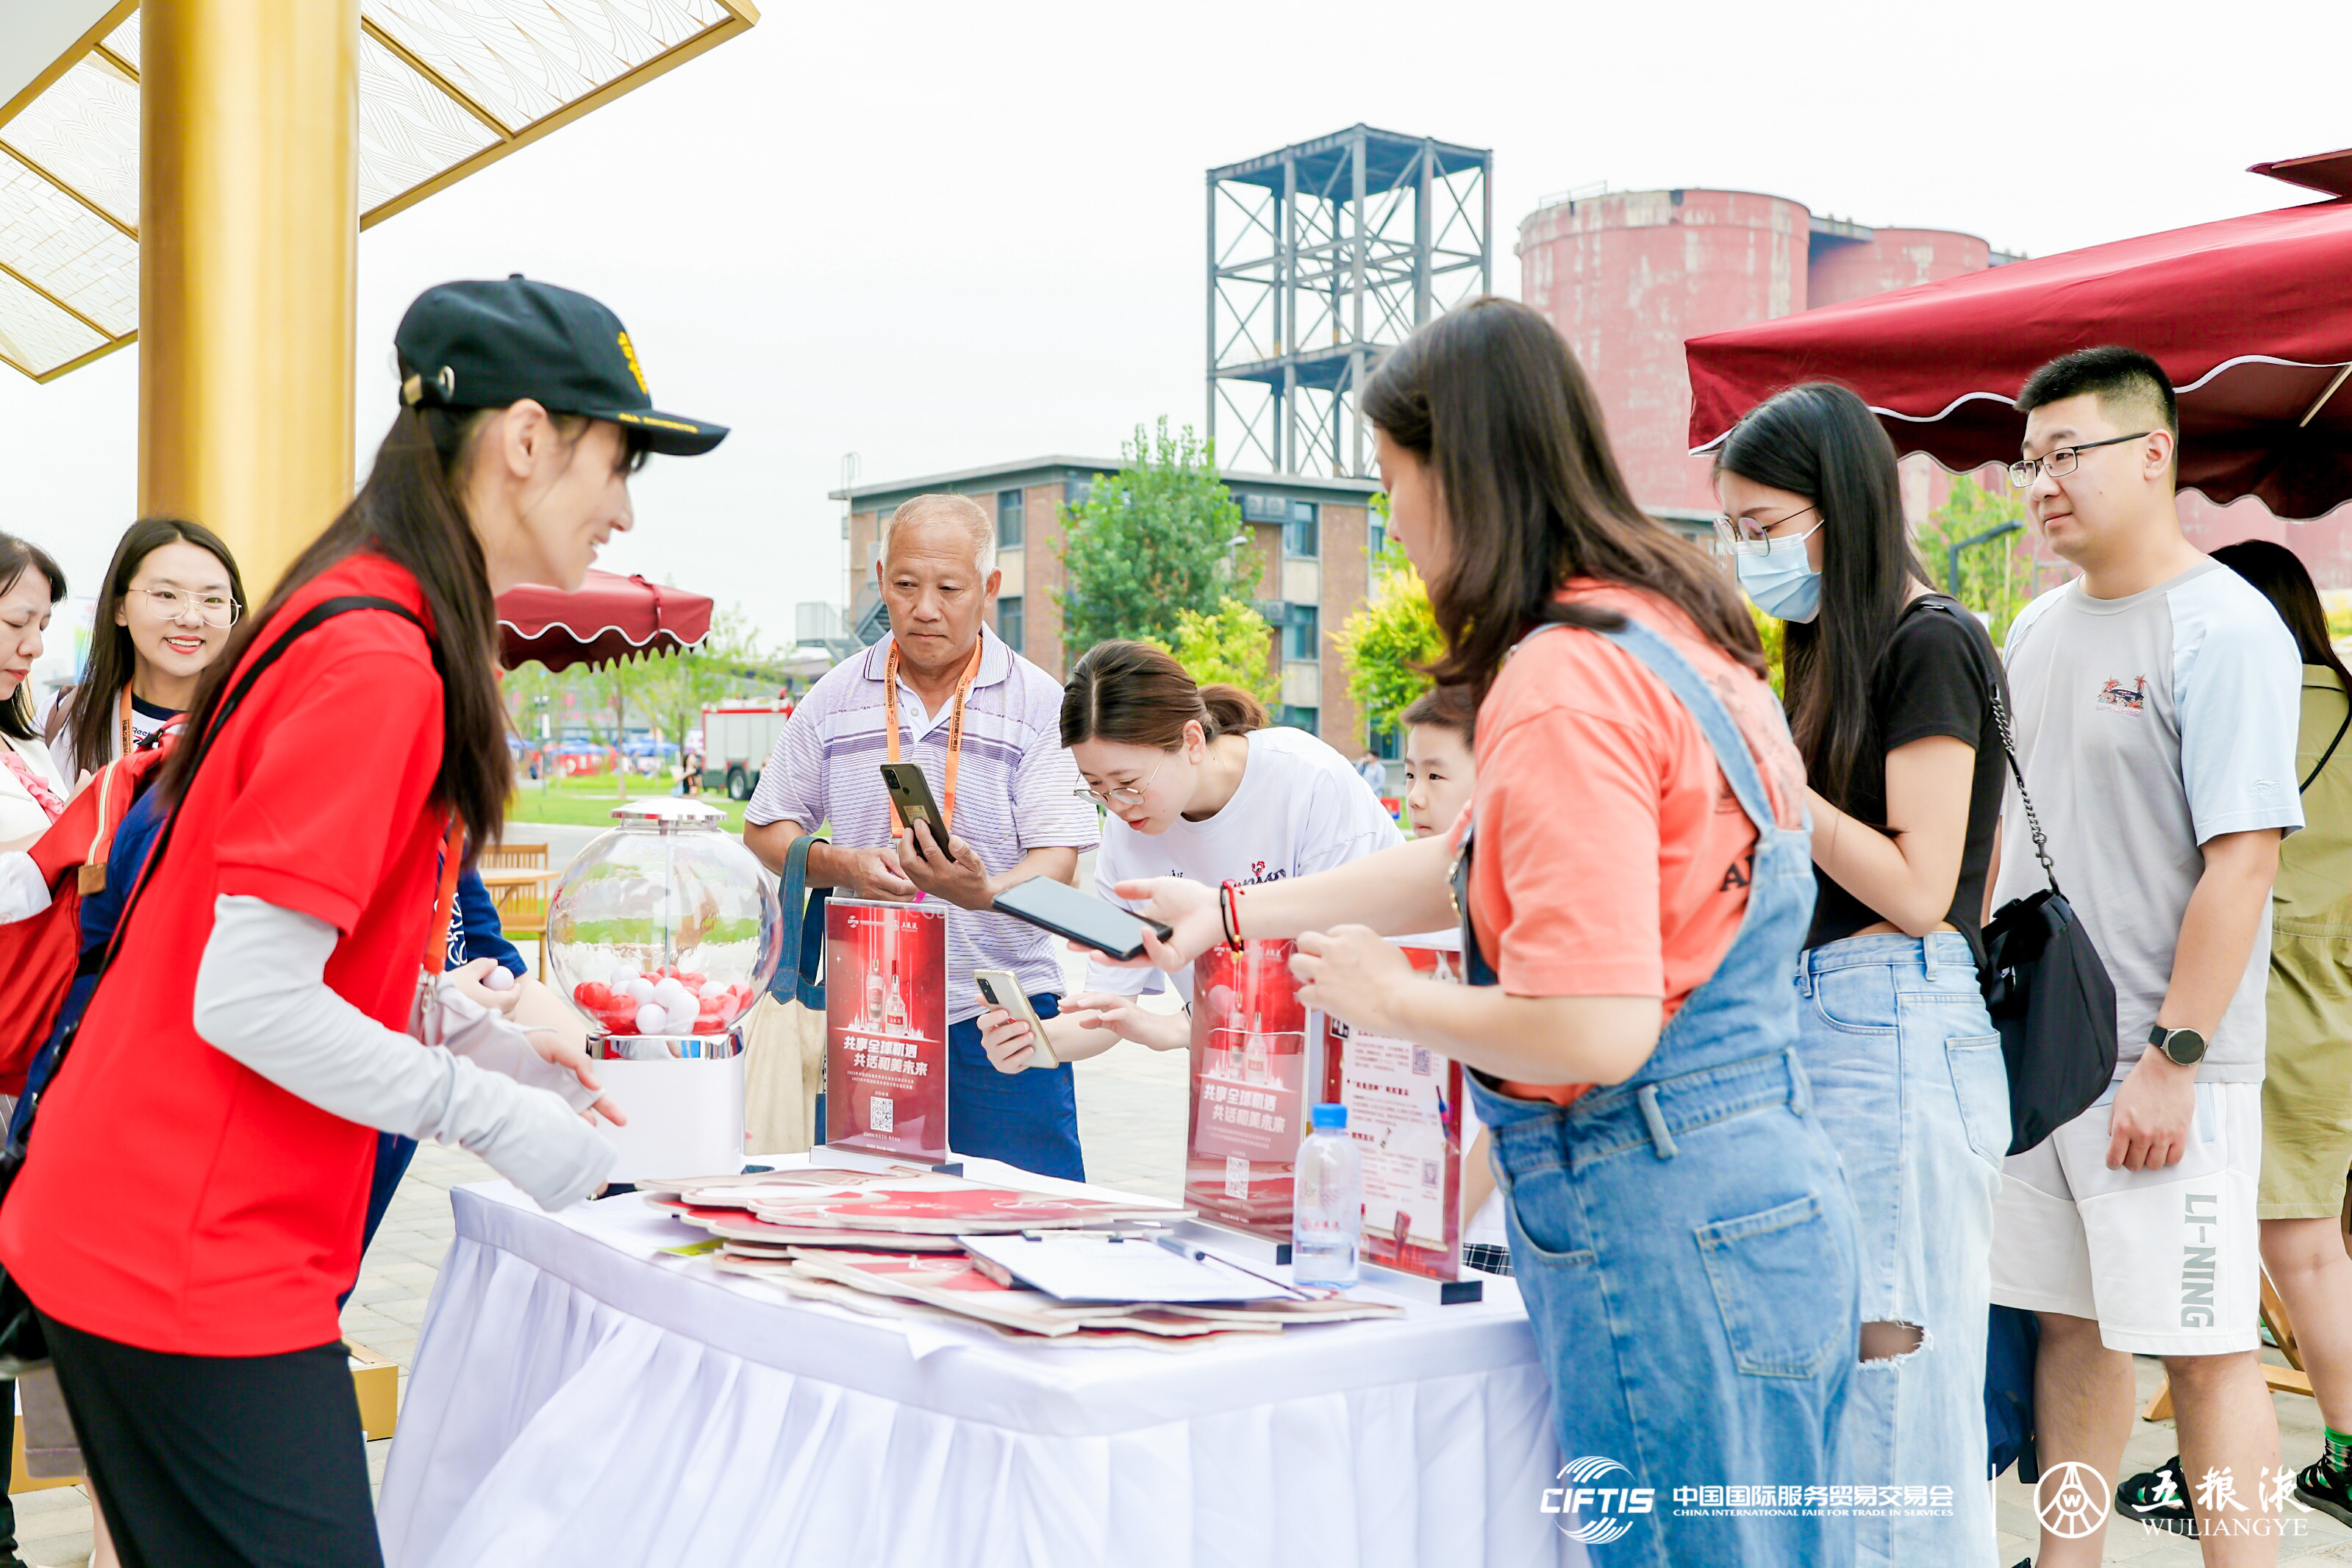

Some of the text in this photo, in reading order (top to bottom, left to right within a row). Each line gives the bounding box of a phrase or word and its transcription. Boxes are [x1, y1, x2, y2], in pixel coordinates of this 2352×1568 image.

[843, 1036, 918, 1059] 共享全球机遇
[854, 1053, 929, 1076] 共话和美未来
[1204, 1084, 1277, 1112] 共享全球机遇
[1212, 1104, 1286, 1134] 共话和美未来
[2181, 1192, 2217, 1328] LI-NING
